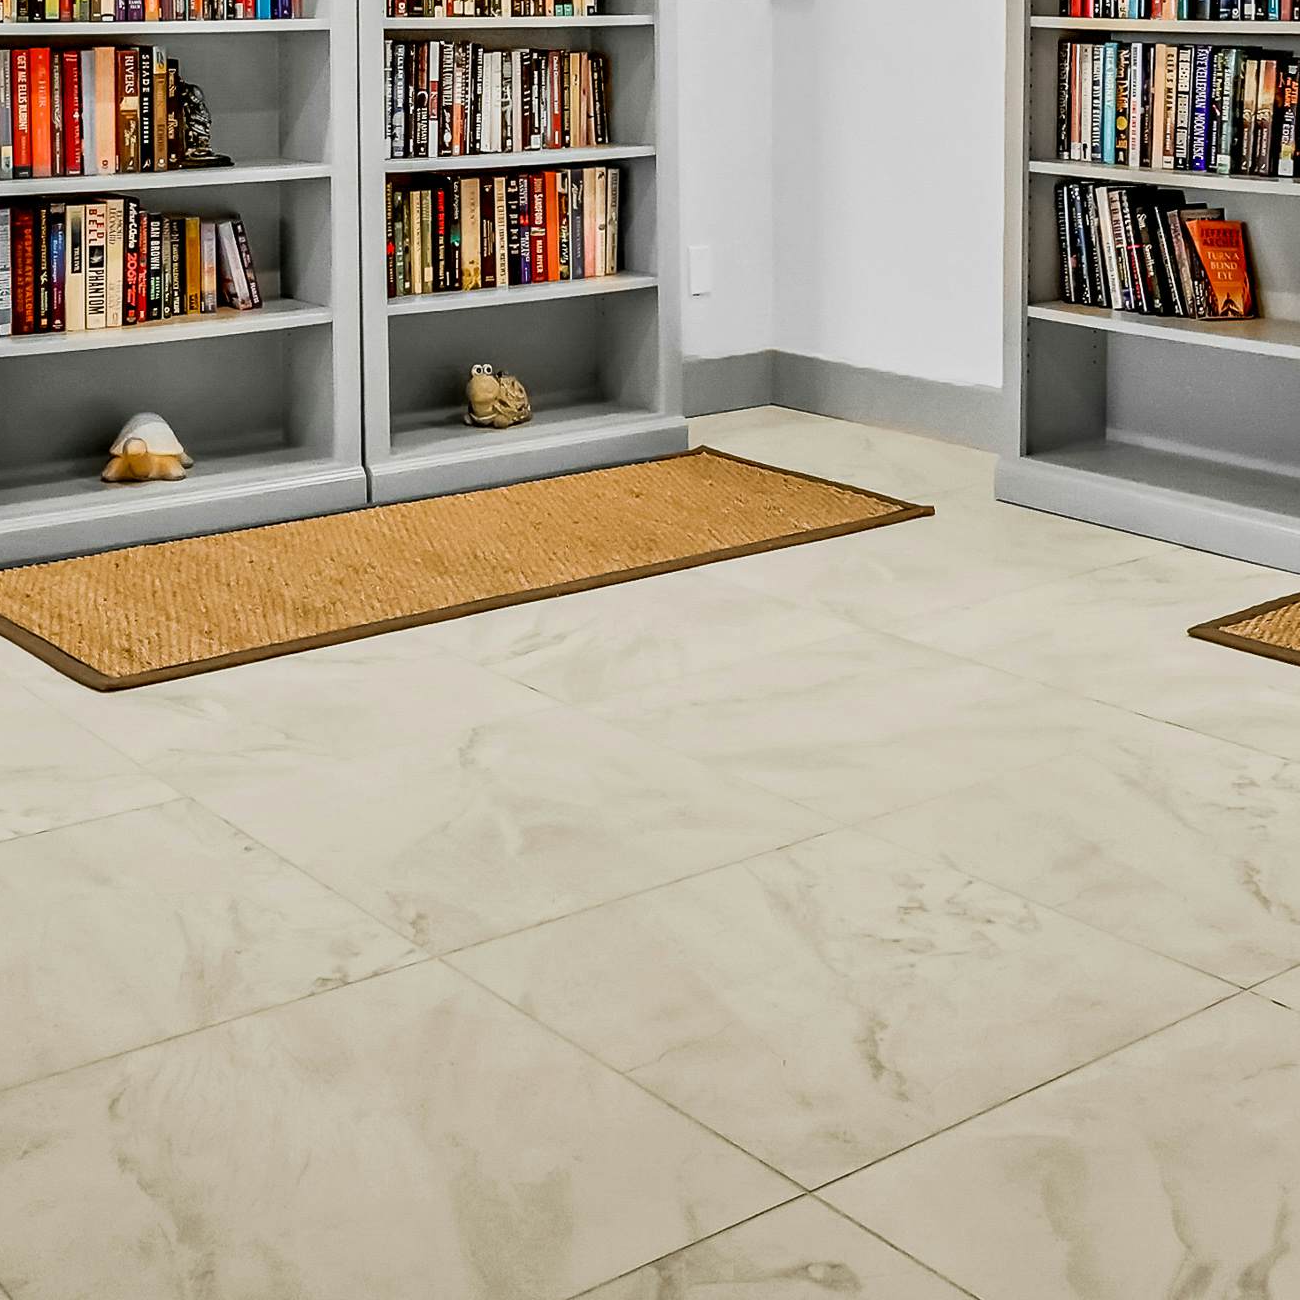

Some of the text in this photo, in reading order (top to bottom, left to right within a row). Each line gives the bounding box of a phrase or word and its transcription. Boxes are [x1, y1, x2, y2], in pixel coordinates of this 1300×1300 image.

[18, 71, 26, 83] ME
[125, 55, 134, 94] RIVERS
[443, 44, 453, 106] PATRICIA CORNWELL
[1116, 50, 1129, 112] Nelson DeMille
[18, 85, 27, 103] ELLIS
[1193, 48, 1210, 160] FAYE KELLERMAN MOON MUSIC
[89, 208, 97, 244] BELL
[534, 194, 543, 224] SANDFORD
[150, 221, 160, 269] DAN BROWN
[1208, 252, 1230, 260] TURN
[1211, 262, 1238, 270] BLIND
[1218, 272, 1232, 280] EYE
[89, 270, 104, 315] PHANTOM
